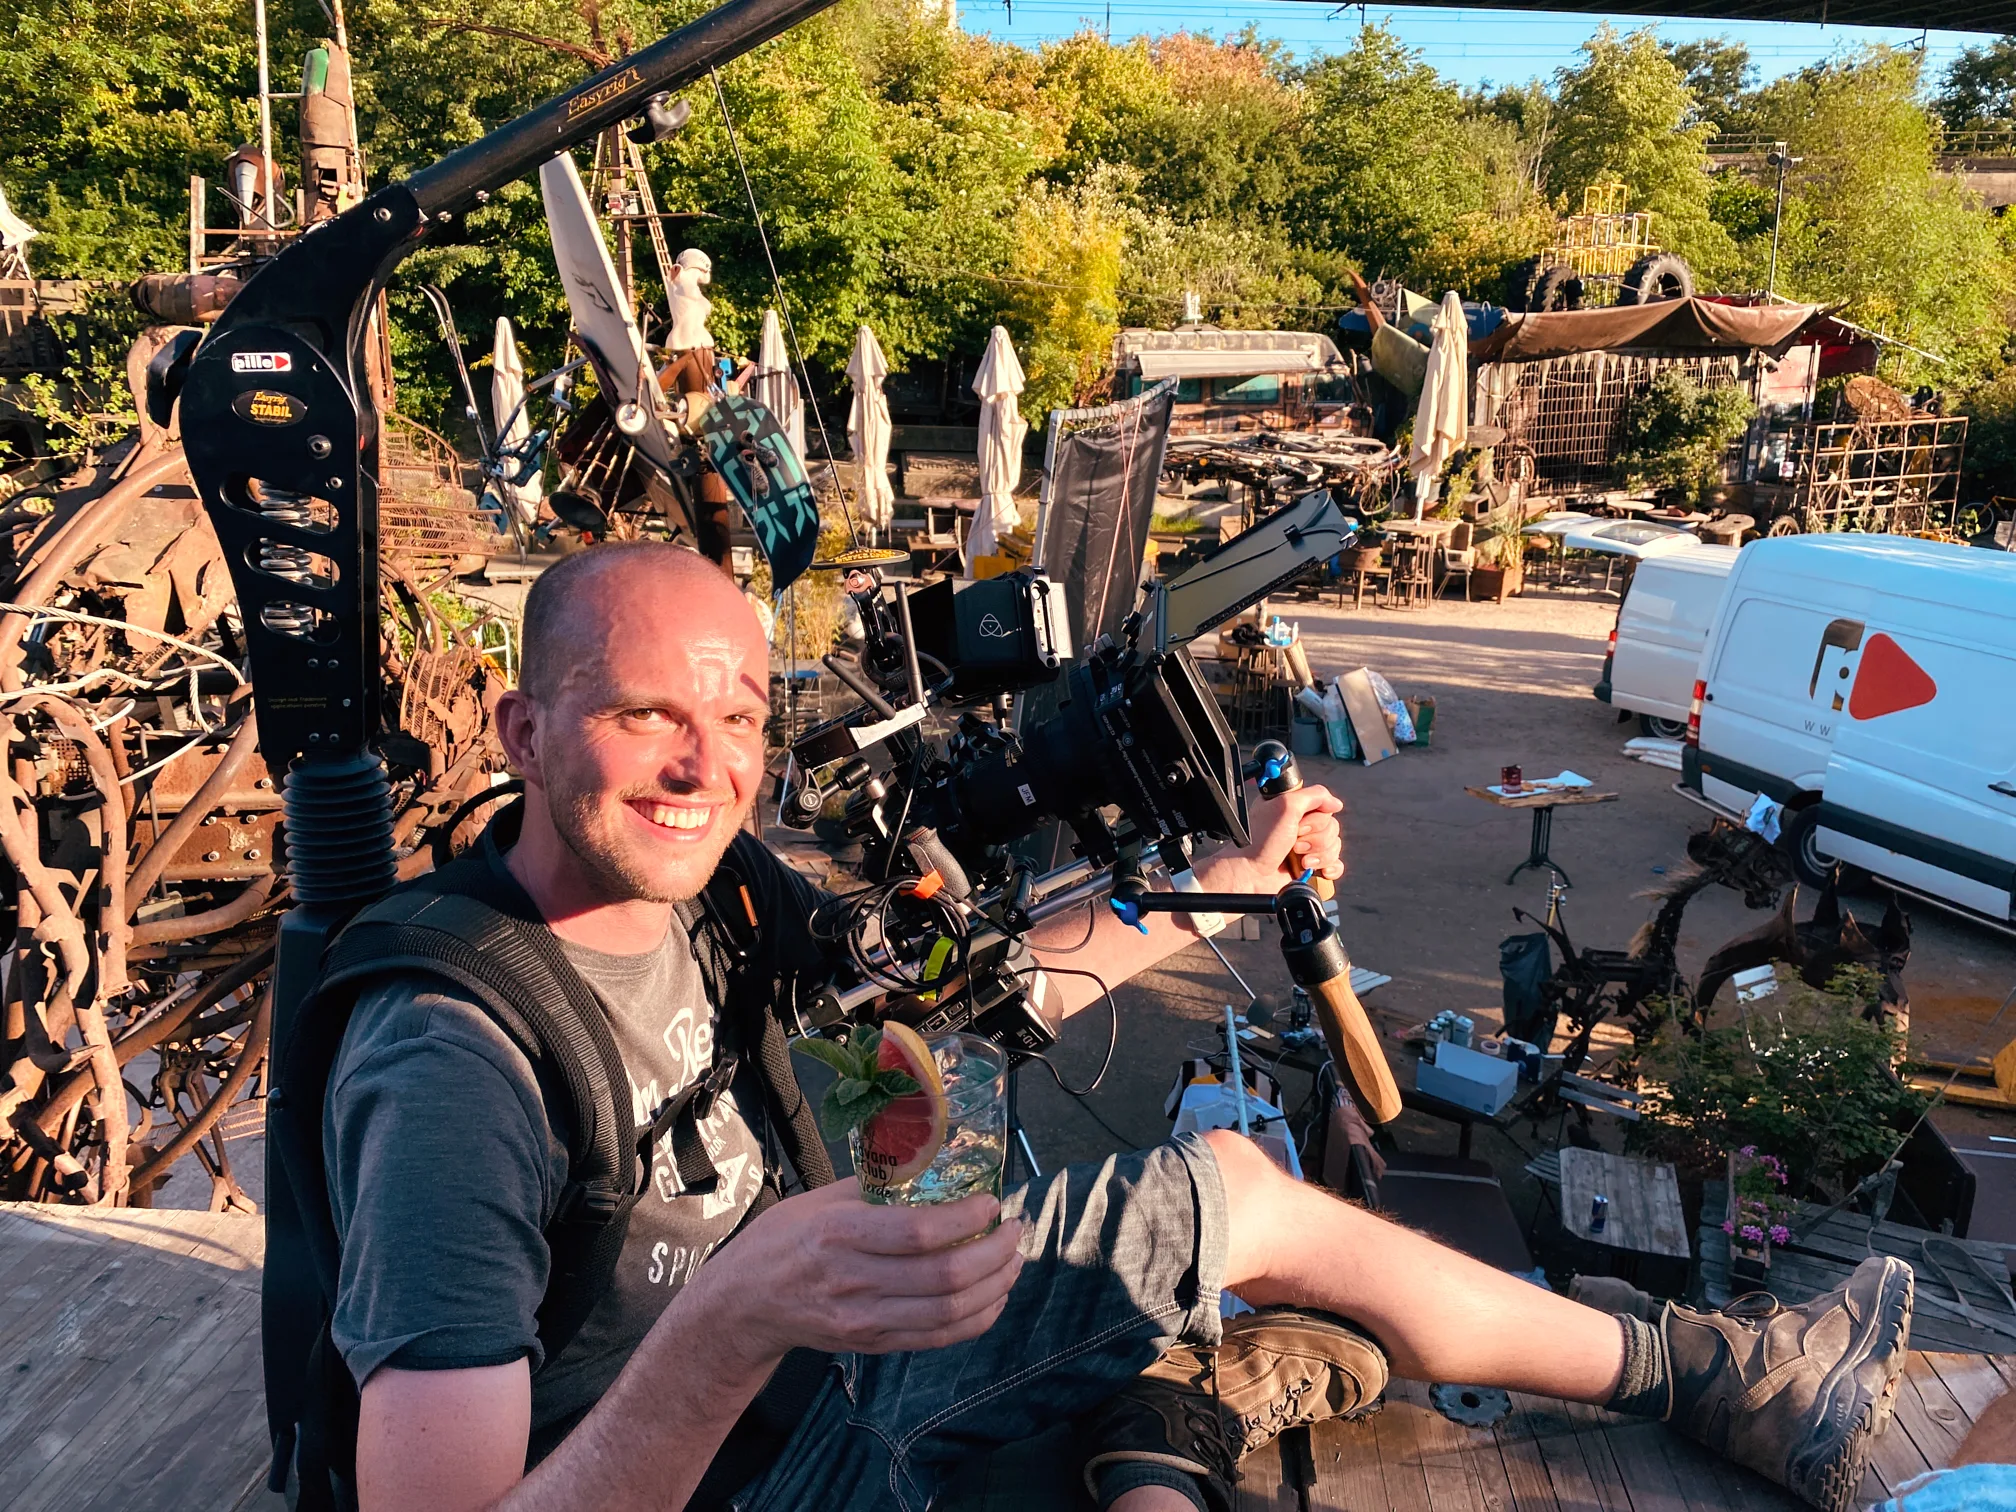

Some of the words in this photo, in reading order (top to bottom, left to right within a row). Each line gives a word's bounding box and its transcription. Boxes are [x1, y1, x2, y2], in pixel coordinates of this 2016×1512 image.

[567, 74, 628, 117] Easyrig
[250, 403, 292, 418] STABIL
[861, 1158, 887, 1180] Club
[861, 1174, 893, 1199] Verde
